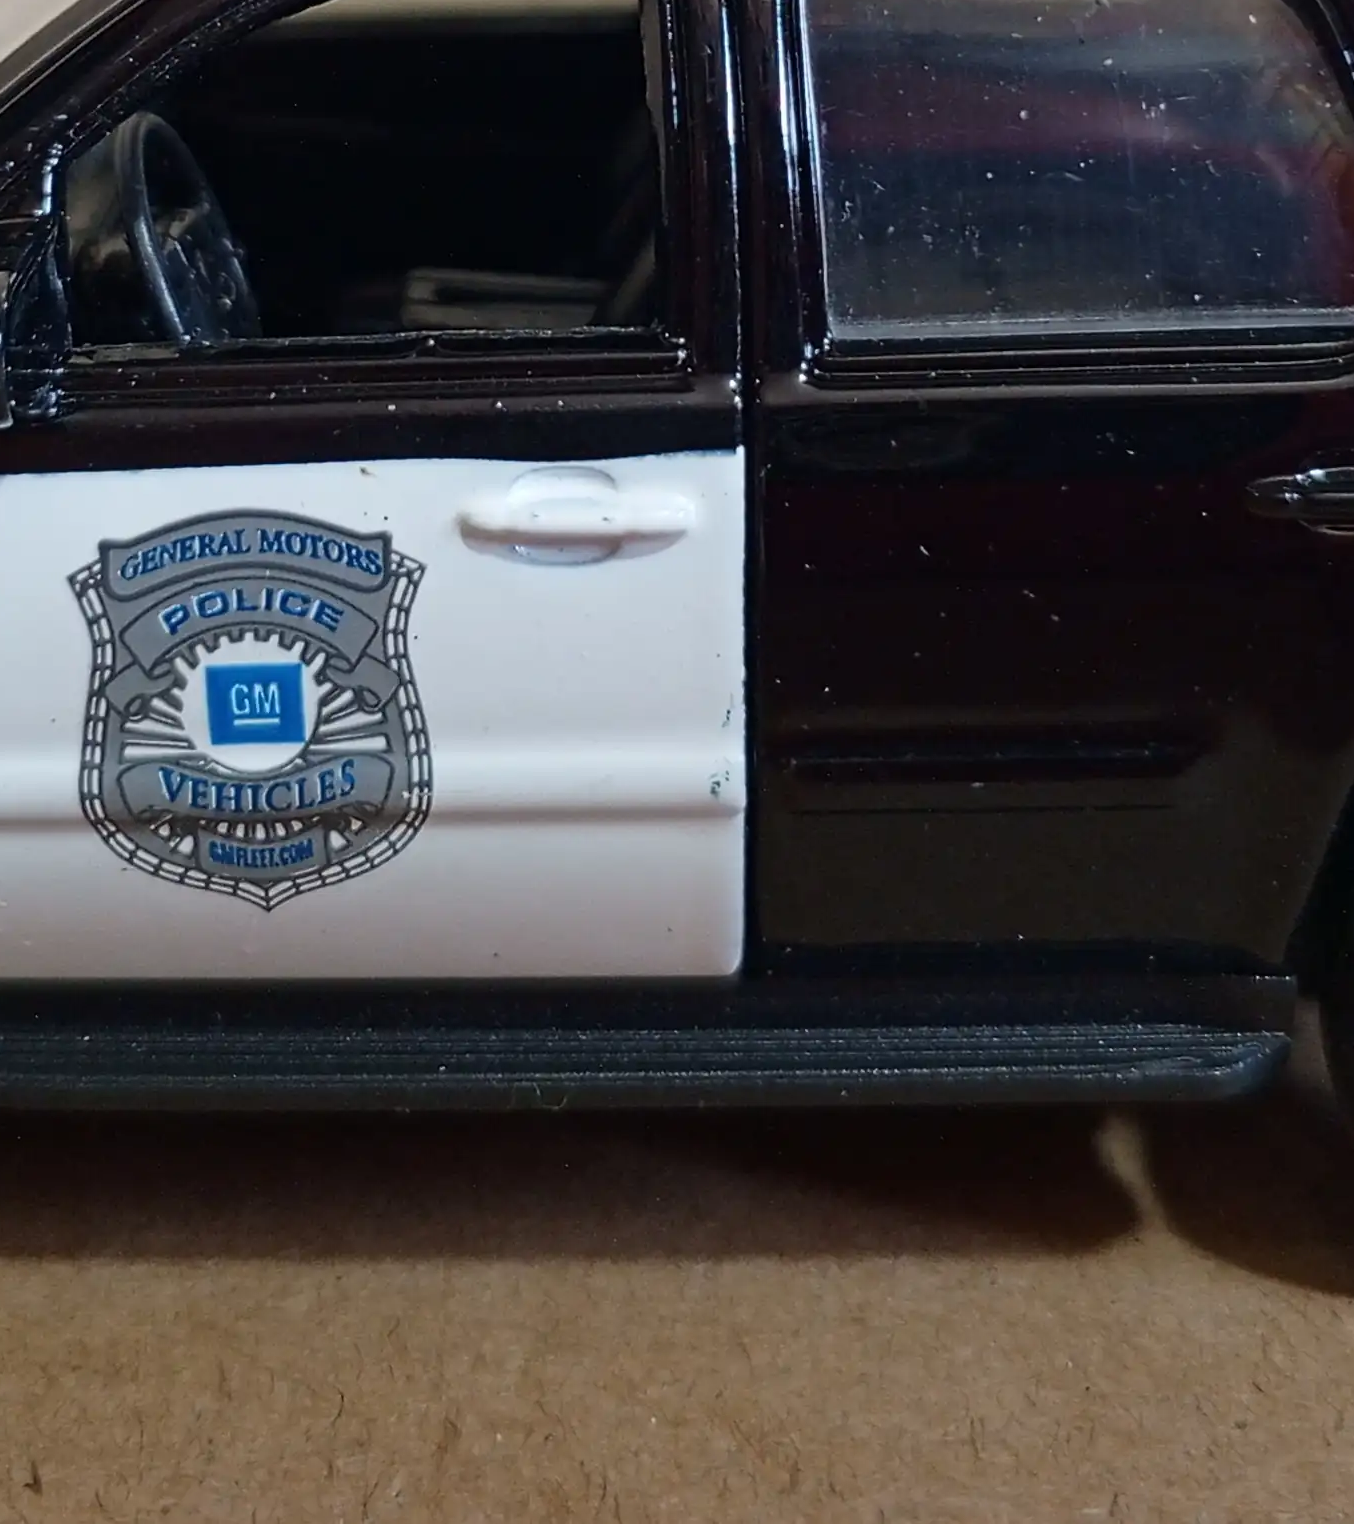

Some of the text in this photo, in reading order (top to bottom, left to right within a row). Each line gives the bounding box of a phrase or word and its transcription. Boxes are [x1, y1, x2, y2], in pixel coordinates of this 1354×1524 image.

[120, 528, 384, 581] GENERAL MOTORS
[158, 586, 345, 636] POLICE
[230, 681, 280, 715] GM
[157, 759, 356, 813] VEHICLES
